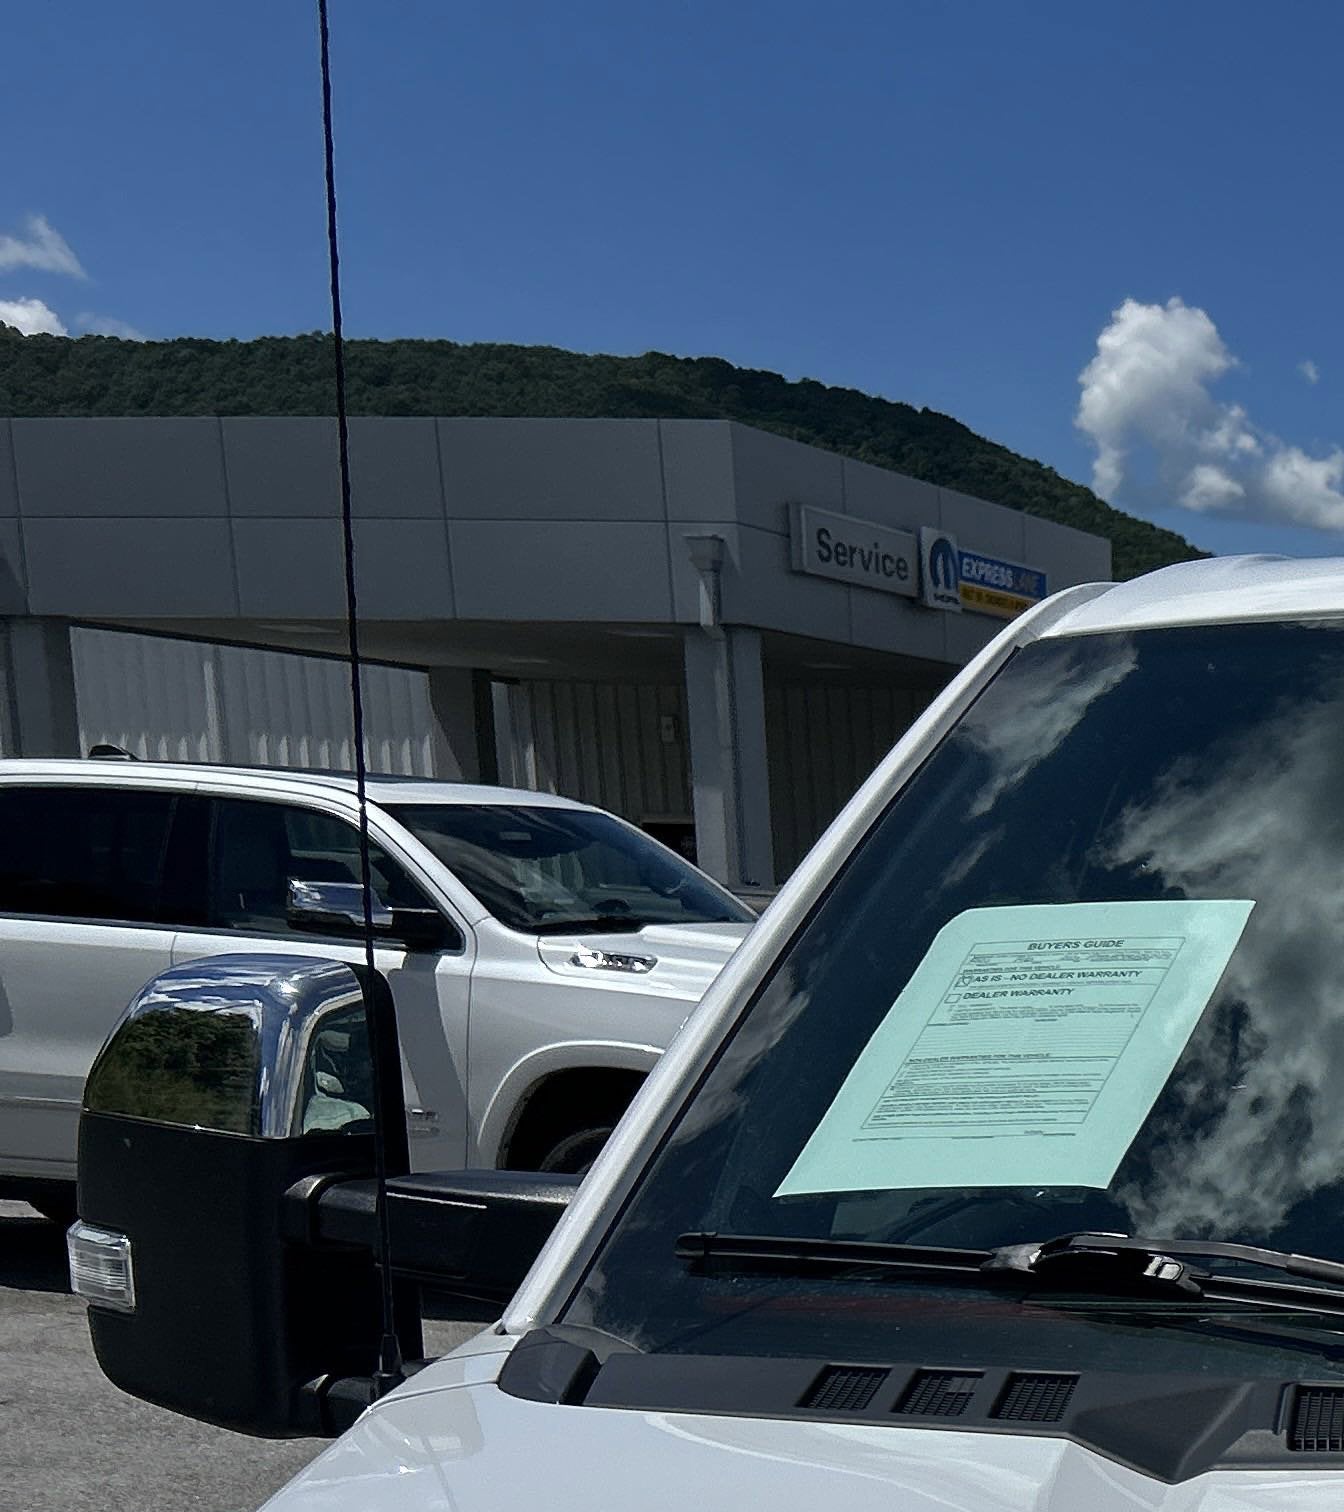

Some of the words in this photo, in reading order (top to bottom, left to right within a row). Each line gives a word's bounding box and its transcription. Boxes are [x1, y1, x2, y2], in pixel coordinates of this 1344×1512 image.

[816, 527, 909, 581] Service
[961, 557, 1014, 588] EXPRESS
[1027, 941, 1081, 951] BUYERS
[1083, 939, 1125, 948] GUIDE
[1010, 973, 1028, 981] NO
[1029, 972, 1075, 980] DEALER
[1077, 970, 1143, 978] WARRANTY
[963, 990, 1009, 999] DEALER
[1010, 988, 1075, 997] WARRANTY
